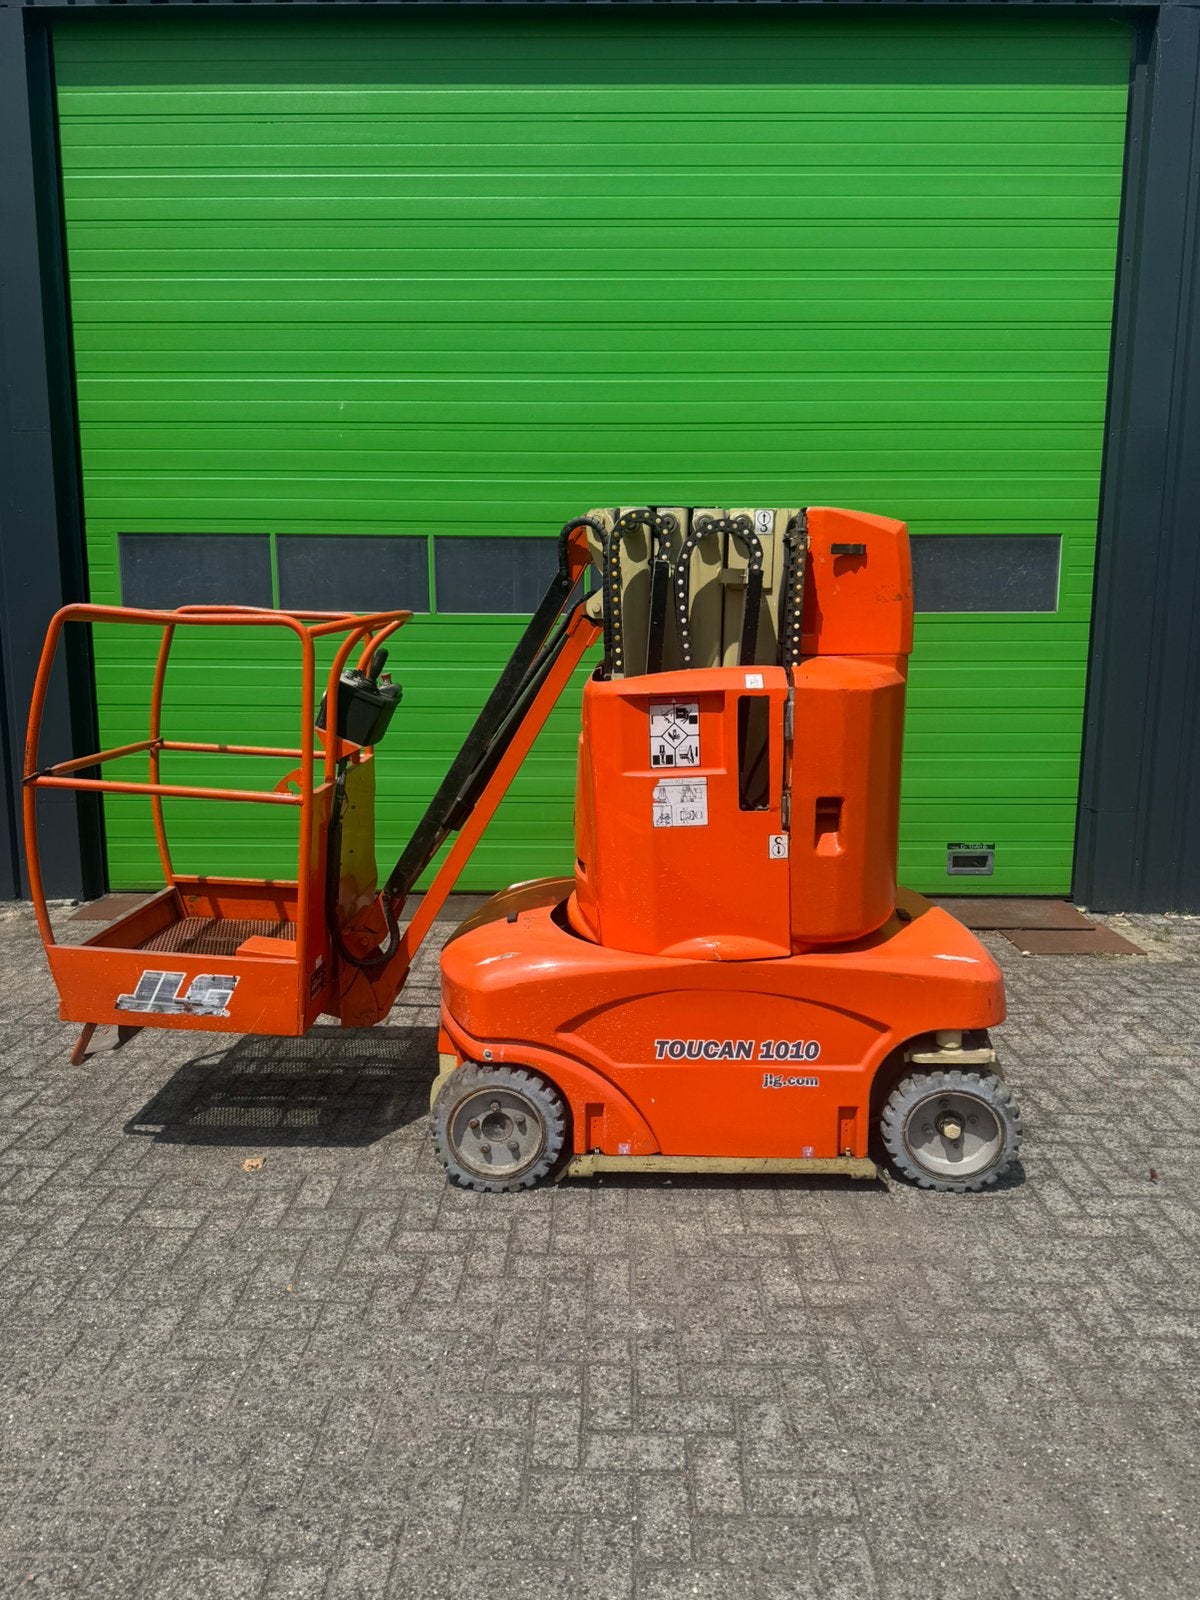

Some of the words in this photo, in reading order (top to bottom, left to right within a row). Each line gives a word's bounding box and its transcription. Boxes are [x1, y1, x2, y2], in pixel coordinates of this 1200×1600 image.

[655, 1039, 755, 1060] TOUCAN
[758, 1040, 820, 1060] 1010
[762, 1073, 819, 1088] jlg.com
